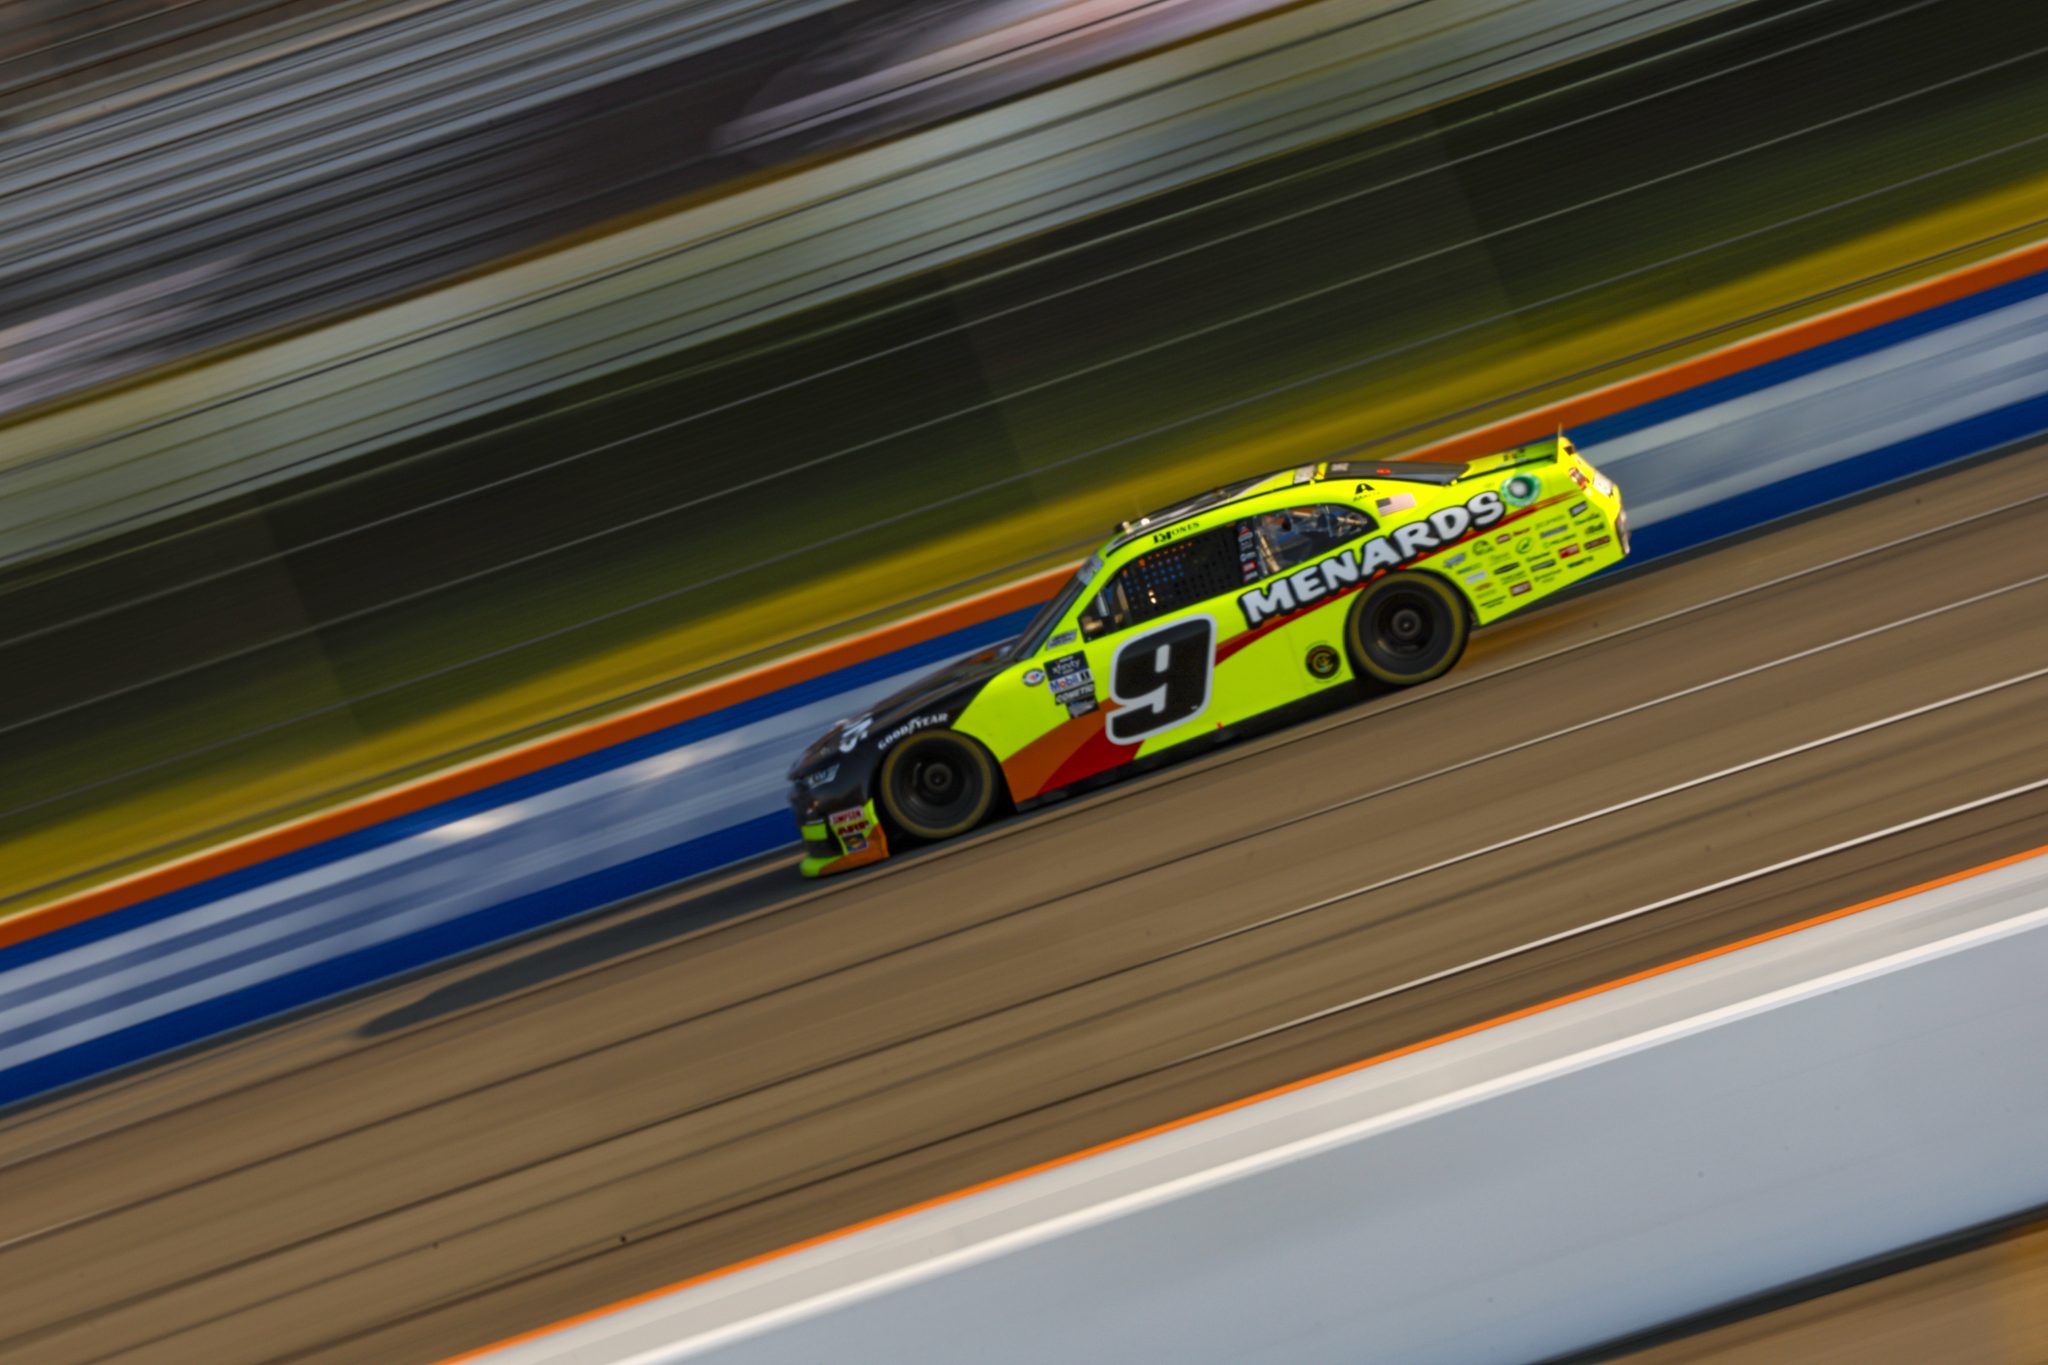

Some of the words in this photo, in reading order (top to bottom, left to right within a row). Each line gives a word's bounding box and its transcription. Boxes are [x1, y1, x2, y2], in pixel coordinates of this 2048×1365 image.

[1239, 490, 1504, 628] MENARDS
[1050, 673, 1080, 691] Mobil
[1107, 614, 1216, 745] 9
[878, 713, 948, 750] GOODYEAR
